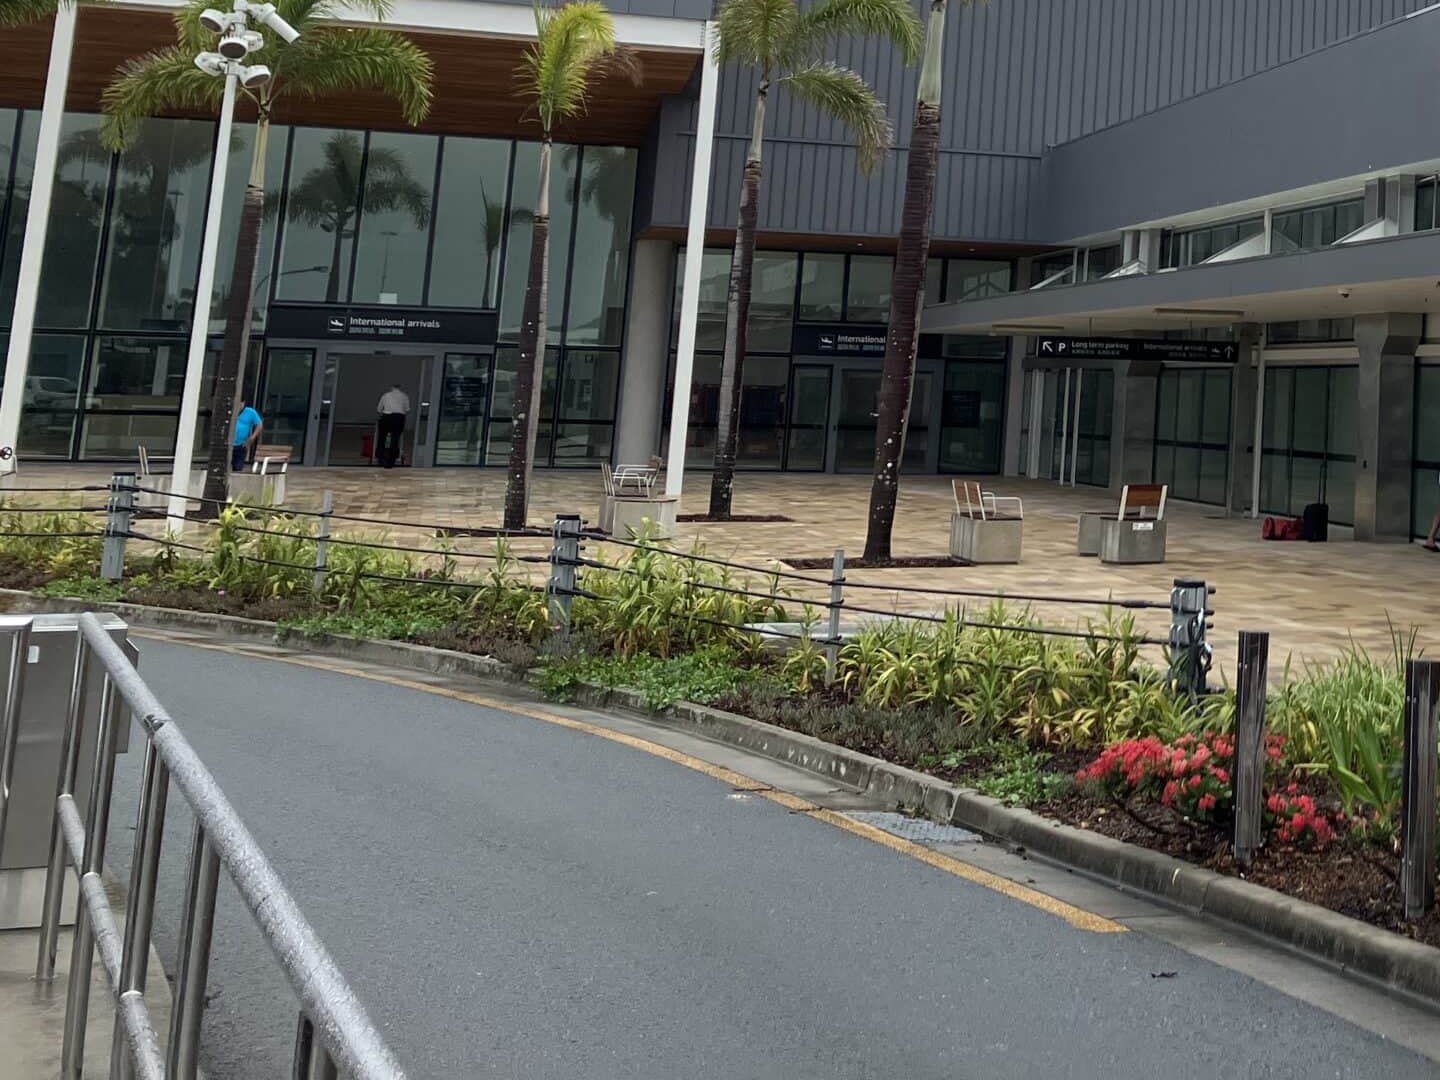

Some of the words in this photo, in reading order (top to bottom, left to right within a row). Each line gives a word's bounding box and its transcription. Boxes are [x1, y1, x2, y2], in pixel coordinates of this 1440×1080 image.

[350, 317, 405, 328] International
[407, 319, 441, 329] arrivals
[837, 334, 886, 344] International
[1058, 342, 1066, 352] P
